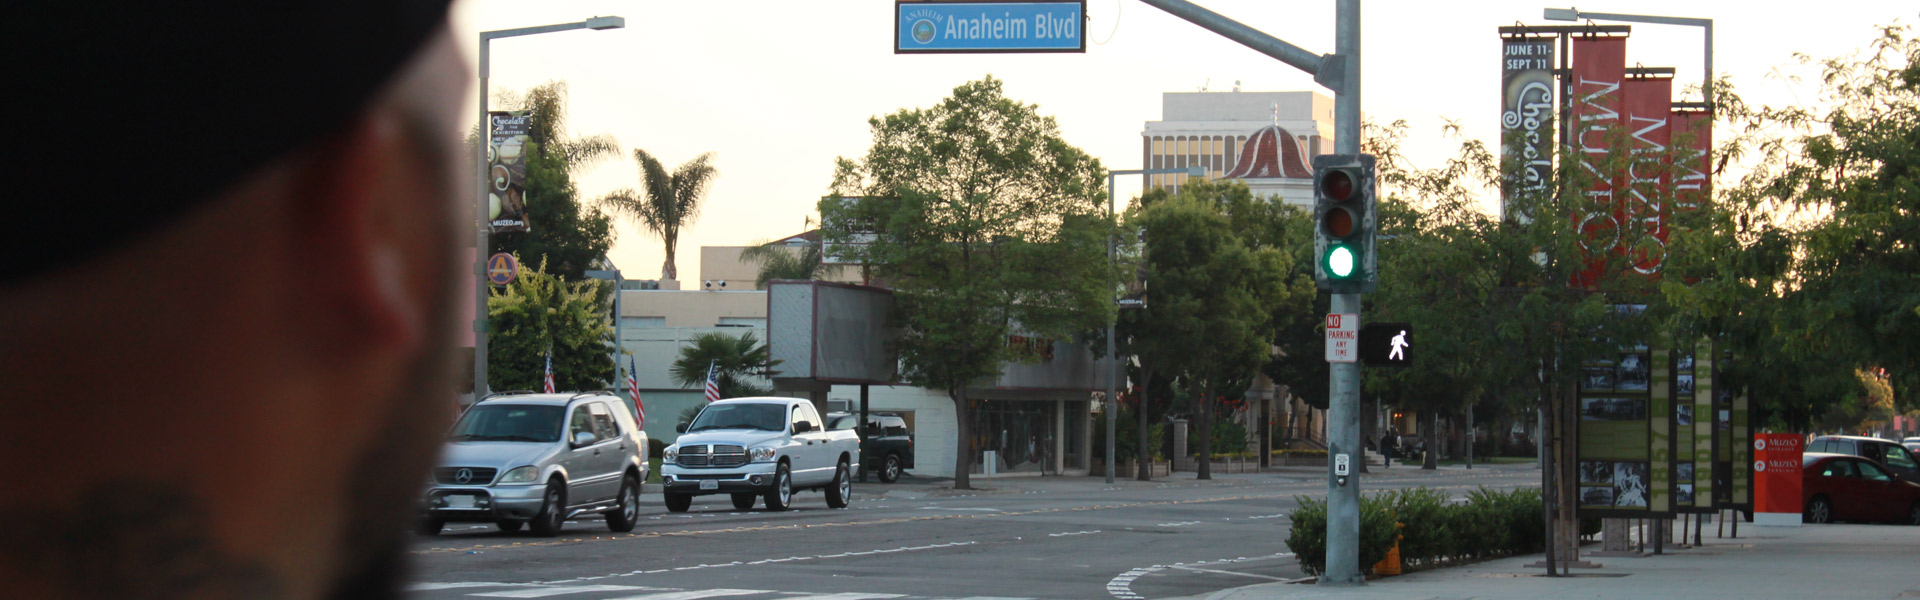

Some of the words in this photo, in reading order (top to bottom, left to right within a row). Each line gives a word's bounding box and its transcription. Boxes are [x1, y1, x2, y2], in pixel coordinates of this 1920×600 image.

[905, 9, 944, 23] ANAHEIM
[944, 12, 1027, 39] Anaheim
[1035, 12, 1075, 39] Blvd
[1505, 45, 1532, 55] JUNE
[1537, 45, 1552, 55] 11-
[1507, 59, 1531, 69] SEPT
[1537, 60, 1546, 69] 11
[492, 115, 525, 130] Chocolate
[1502, 82, 1551, 200] Chocolat
[1628, 113, 1667, 274] MUZEO
[491, 257, 510, 277] A
[1328, 315, 1339, 327] NO
[1328, 330, 1355, 340] PARKING
[1335, 349, 1347, 357] TIME
